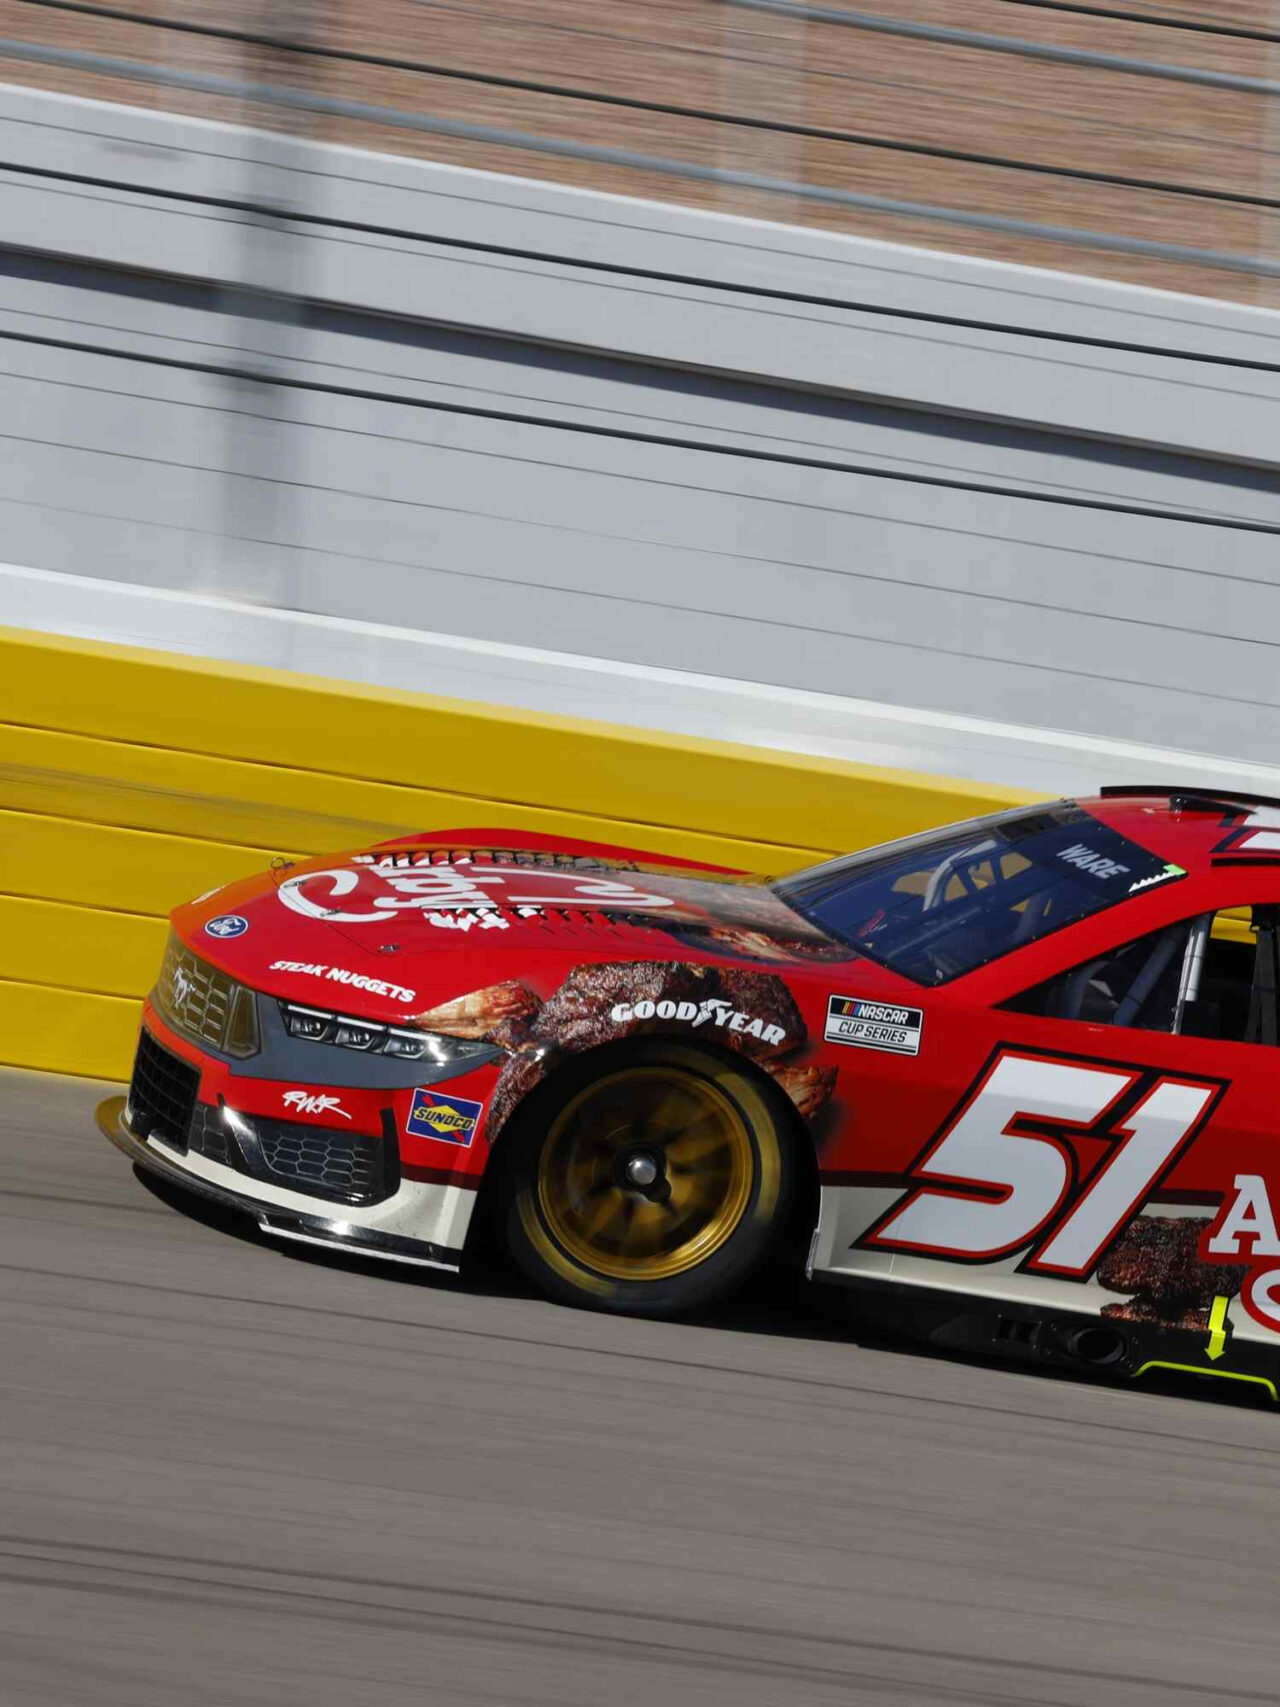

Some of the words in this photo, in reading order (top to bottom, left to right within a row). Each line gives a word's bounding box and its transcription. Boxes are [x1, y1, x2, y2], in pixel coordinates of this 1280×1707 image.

[1056, 842, 1130, 880] WARE
[269, 960, 328, 977] STEAK
[326, 967, 416, 1003] NUGGETS
[858, 1004, 909, 1025] NASCAR
[839, 1021, 864, 1036] CUP
[864, 1026, 907, 1043] SERIES
[415, 1107, 475, 1131] SUNOCO
[868, 1048, 1220, 1272] 51
